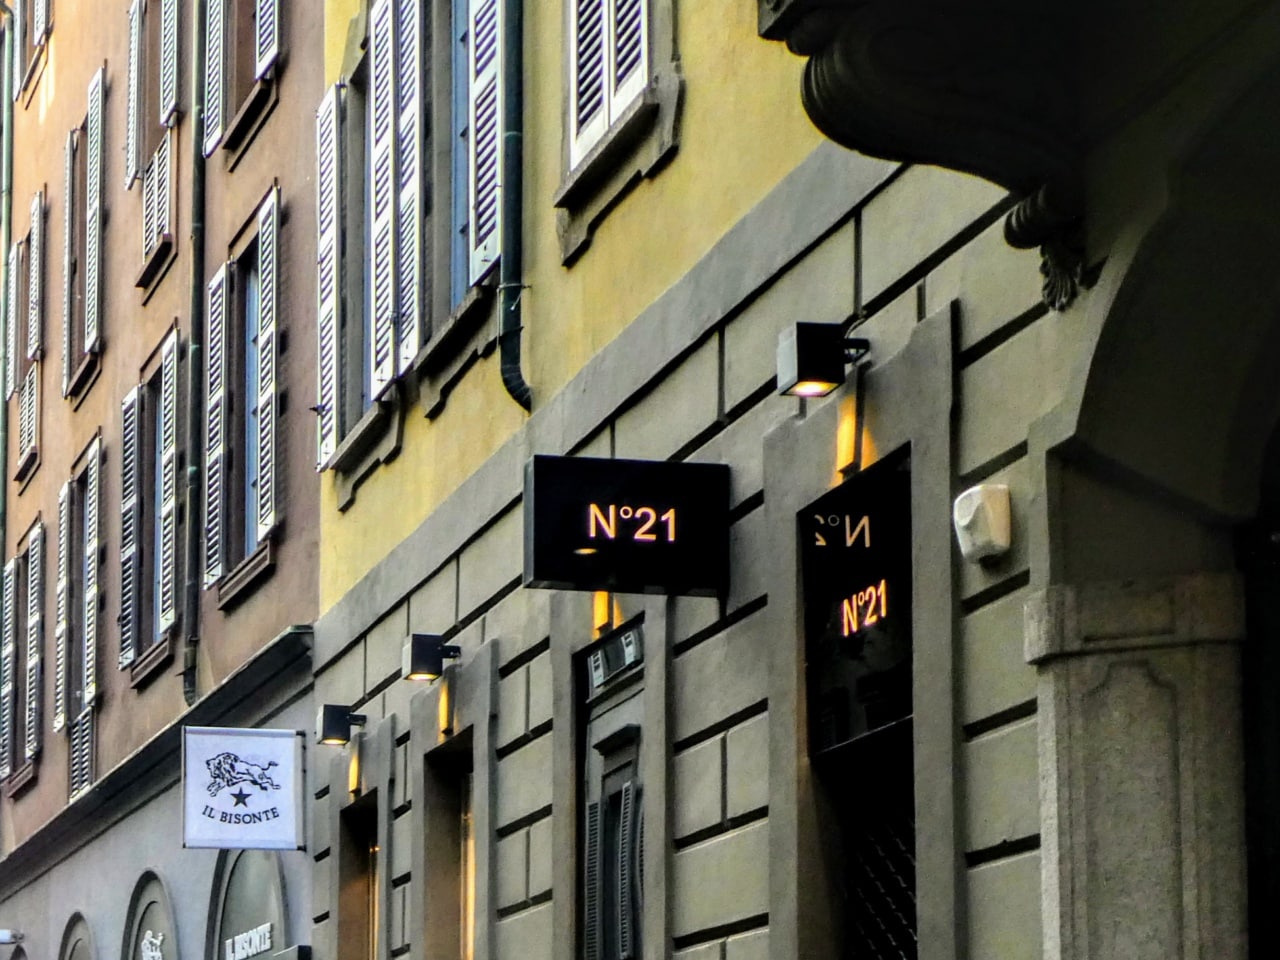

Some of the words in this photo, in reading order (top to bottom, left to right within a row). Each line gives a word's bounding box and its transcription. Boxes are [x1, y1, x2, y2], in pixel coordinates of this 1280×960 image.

[589, 503, 676, 542] N°21
[842, 578, 887, 637] N°21
[202, 805, 215, 819] IL
[219, 806, 280, 825] BISONTE
